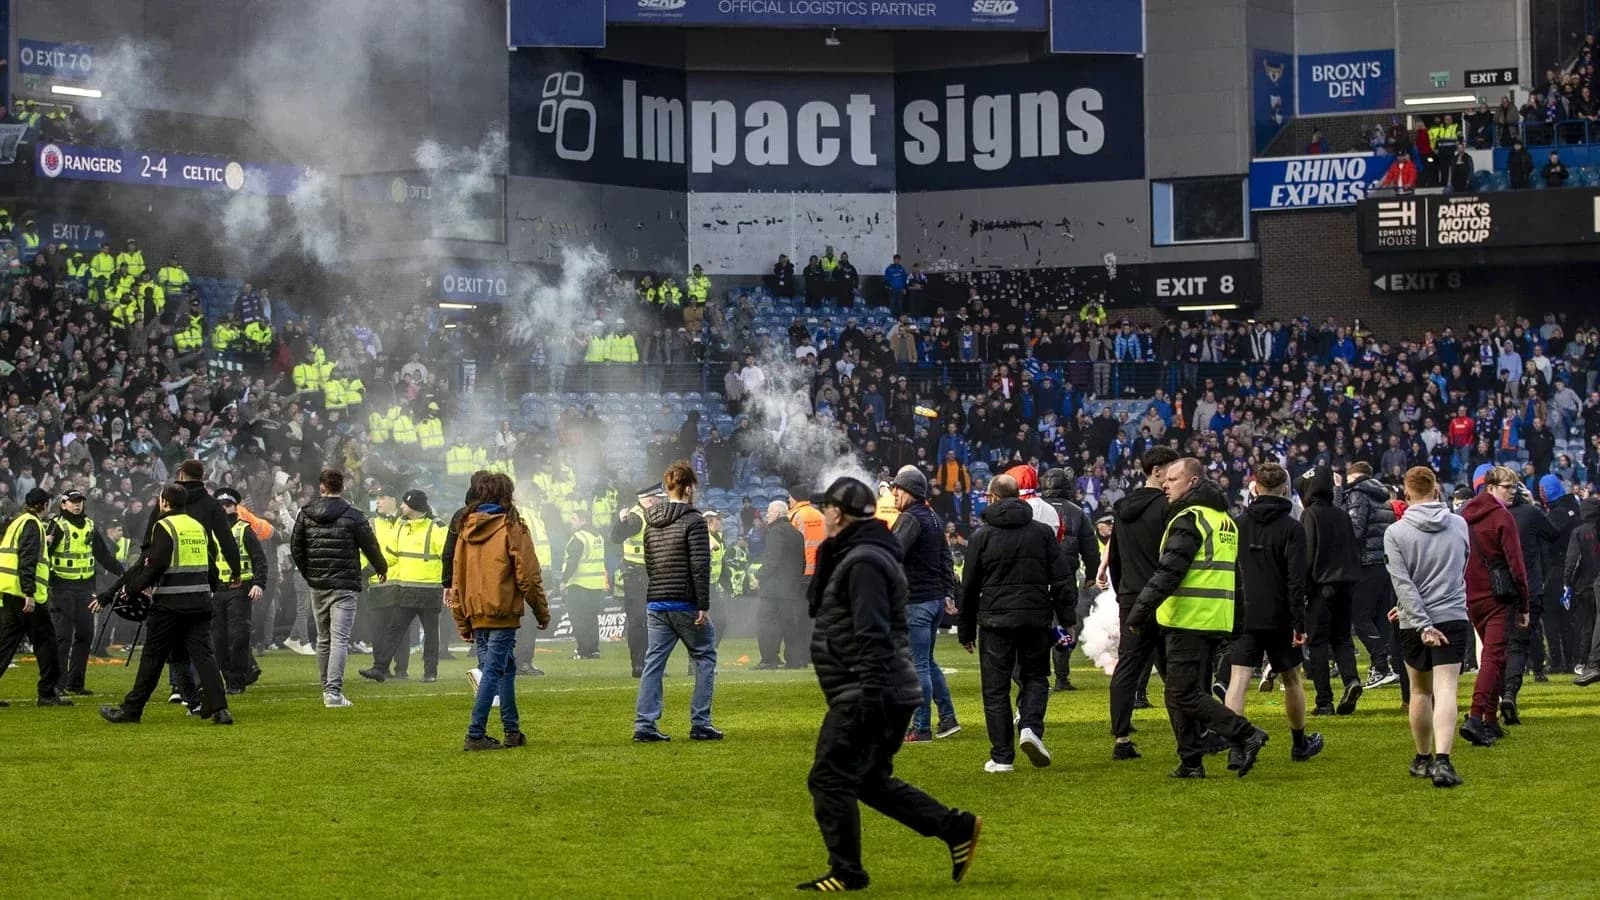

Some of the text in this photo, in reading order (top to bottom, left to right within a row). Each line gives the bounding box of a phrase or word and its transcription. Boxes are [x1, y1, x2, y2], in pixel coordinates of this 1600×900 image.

[718, 0, 937, 17] OFFICIAL LOGISTICS PARTNER
[36, 50, 66, 69] EXIT
[1311, 61, 1381, 82] BROXI'S
[1470, 71, 1513, 84] EXIT 8
[1328, 80, 1366, 98] DEN
[622, 79, 1105, 173] Impact signs
[64, 155, 224, 182] RANGERS 2-4 CELTIC
[1285, 158, 1367, 182] RHINO
[1270, 180, 1380, 207] EXPRES
[1438, 203, 1490, 218] PARK'S
[53, 223, 81, 240] EXIT
[1379, 229, 1417, 237] EDMISTON
[1438, 217, 1491, 231] MOTOR
[1379, 235, 1417, 246] HOUSE
[1438, 229, 1489, 244] GROUP
[457, 276, 483, 294] EXIT
[1156, 275, 1234, 296] EXIT 8
[1391, 272, 1461, 291] EXIT 8
